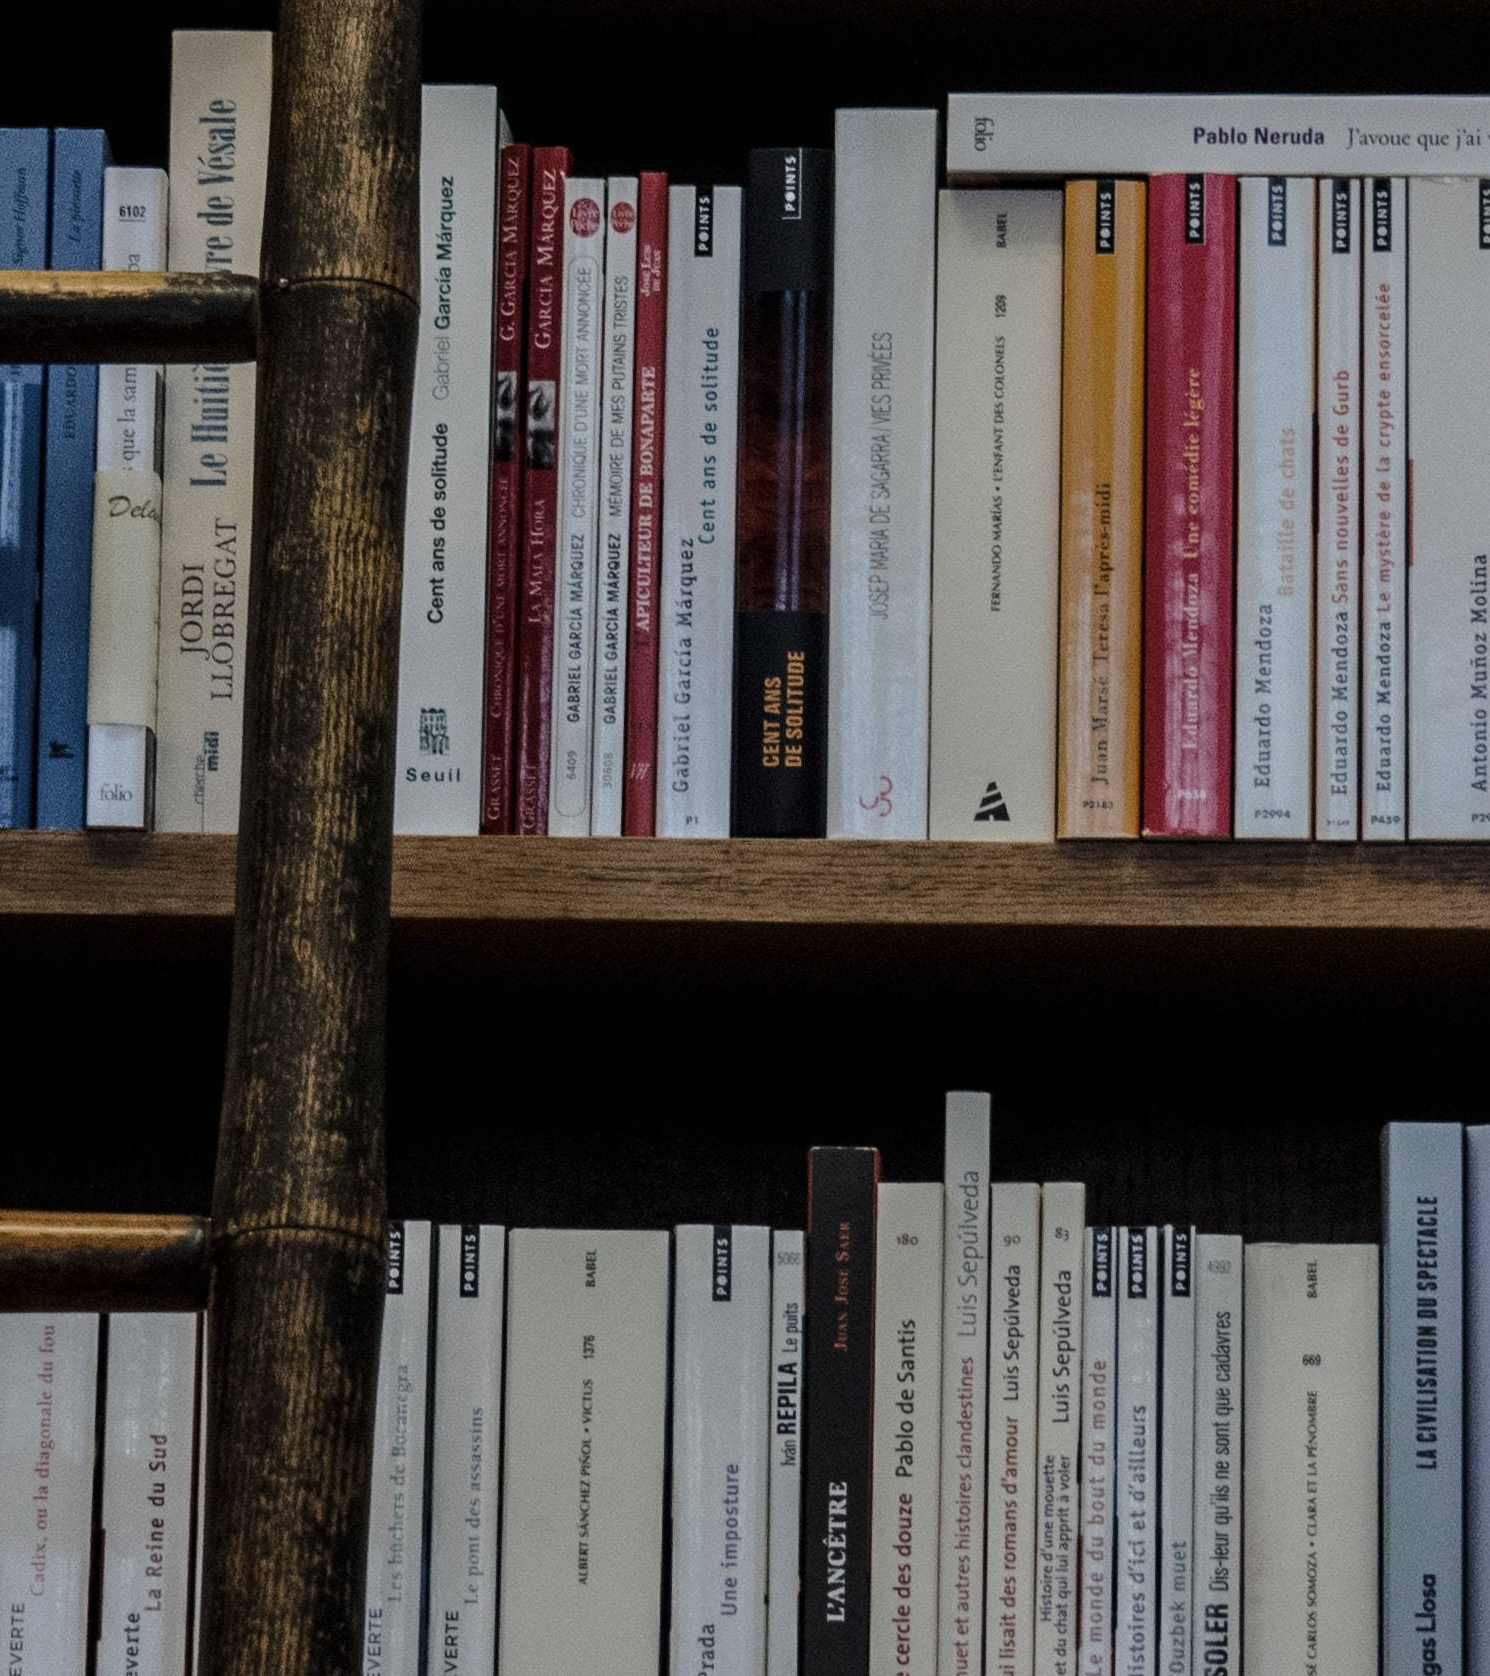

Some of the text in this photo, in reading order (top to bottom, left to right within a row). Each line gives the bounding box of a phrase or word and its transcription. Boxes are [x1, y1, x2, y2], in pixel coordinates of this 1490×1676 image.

[1192, 125, 1248, 145] Pablo
[1252, 125, 1325, 146] Neruda
[1347, 126, 1411, 148] J'avoue
[1415, 133, 1450, 152] que
[1455, 128, 1481, 150] j'ai
[425, 176, 457, 625] Cent ans de solitude Gabriel García Márquez
[178, 564, 210, 660] JORDI
[209, 517, 237, 701] LLOBREGAT
[1329, 370, 1350, 796] Eduardo Mendoza Sans nouvelles de Gurb
[762, 676, 783, 768] CENT ANS
[784, 651, 805, 768] DE SOLITUDE
[776, 1302, 801, 1466] Iván REPILA Le puits
[1051, 1270, 1075, 1424] Luis Sepúlveda
[1415, 1196, 1438, 1470] LA CIVILISATION DU SPECTACLE
[144, 1434, 167, 1612] La Reine du Sud
[821, 1481, 848, 1623] L'ANCÊTRE
